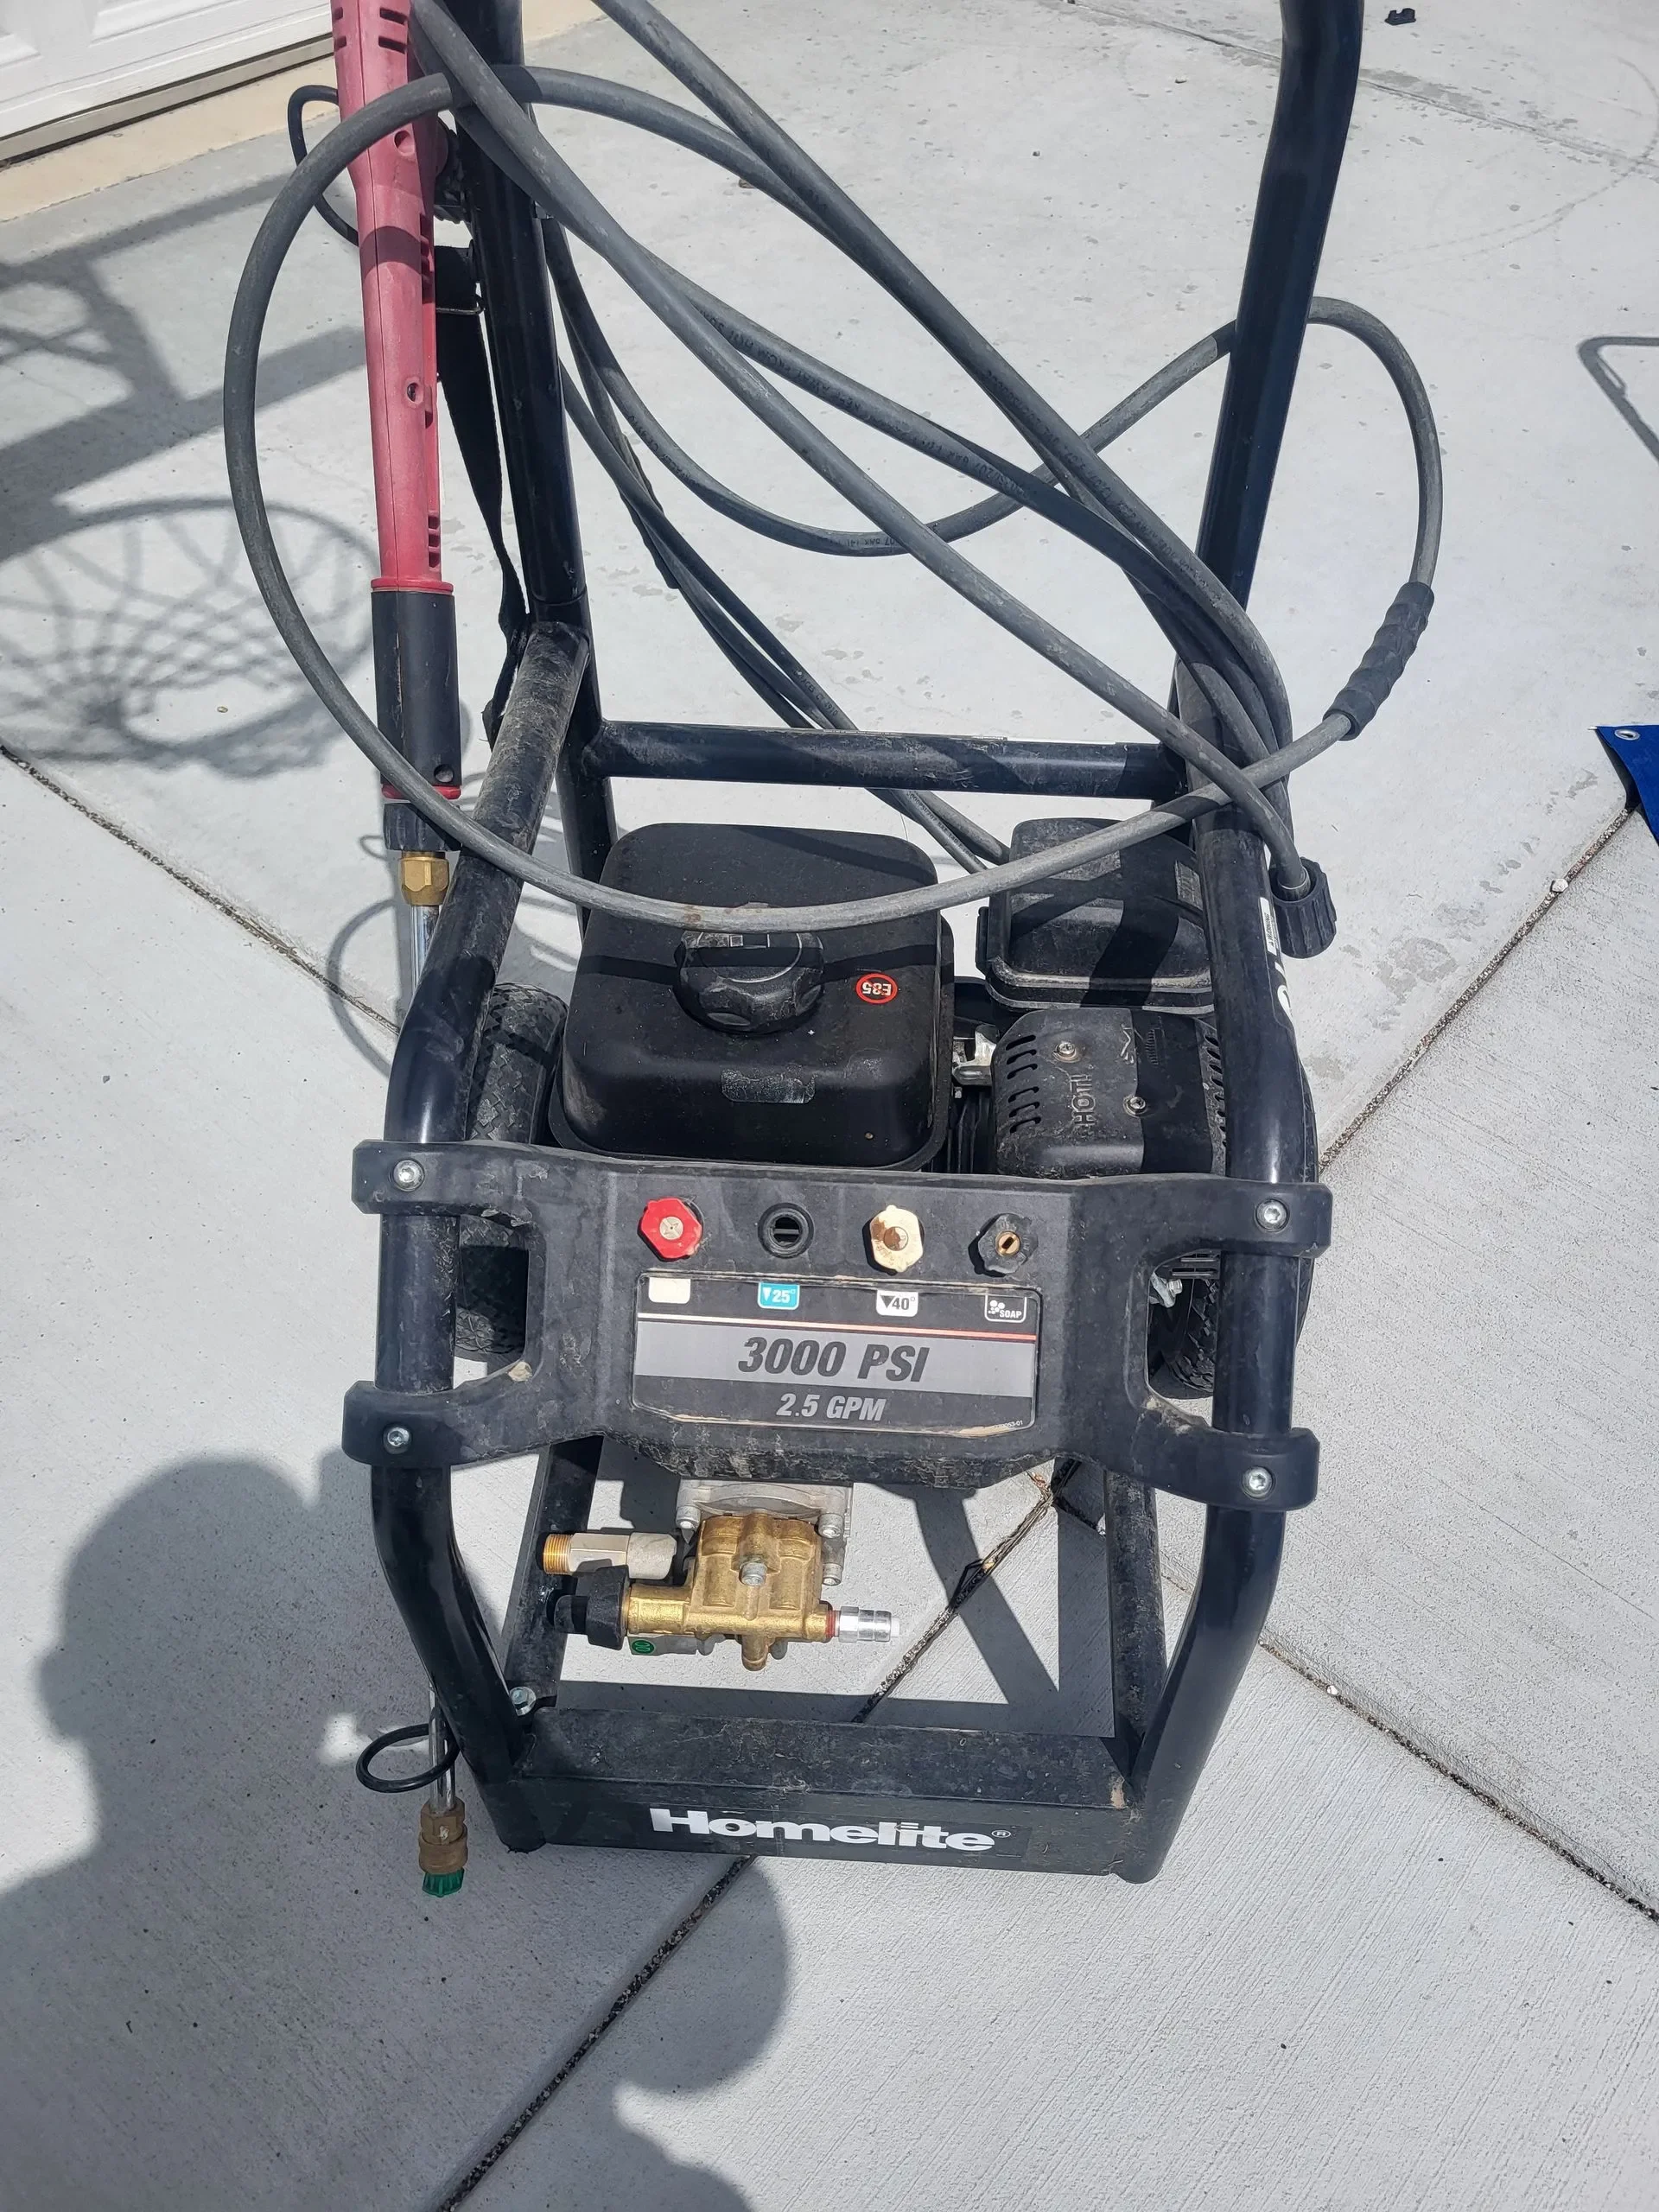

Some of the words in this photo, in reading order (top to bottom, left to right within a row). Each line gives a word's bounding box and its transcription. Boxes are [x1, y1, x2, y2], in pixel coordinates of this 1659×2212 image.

[861, 982, 892, 996] E85
[999, 1310, 1022, 1319] SOAP
[738, 1337, 846, 1377] 3000
[857, 1344, 931, 1382] PSI
[776, 1393, 821, 1418] 2.5
[826, 1395, 887, 1421] GPM
